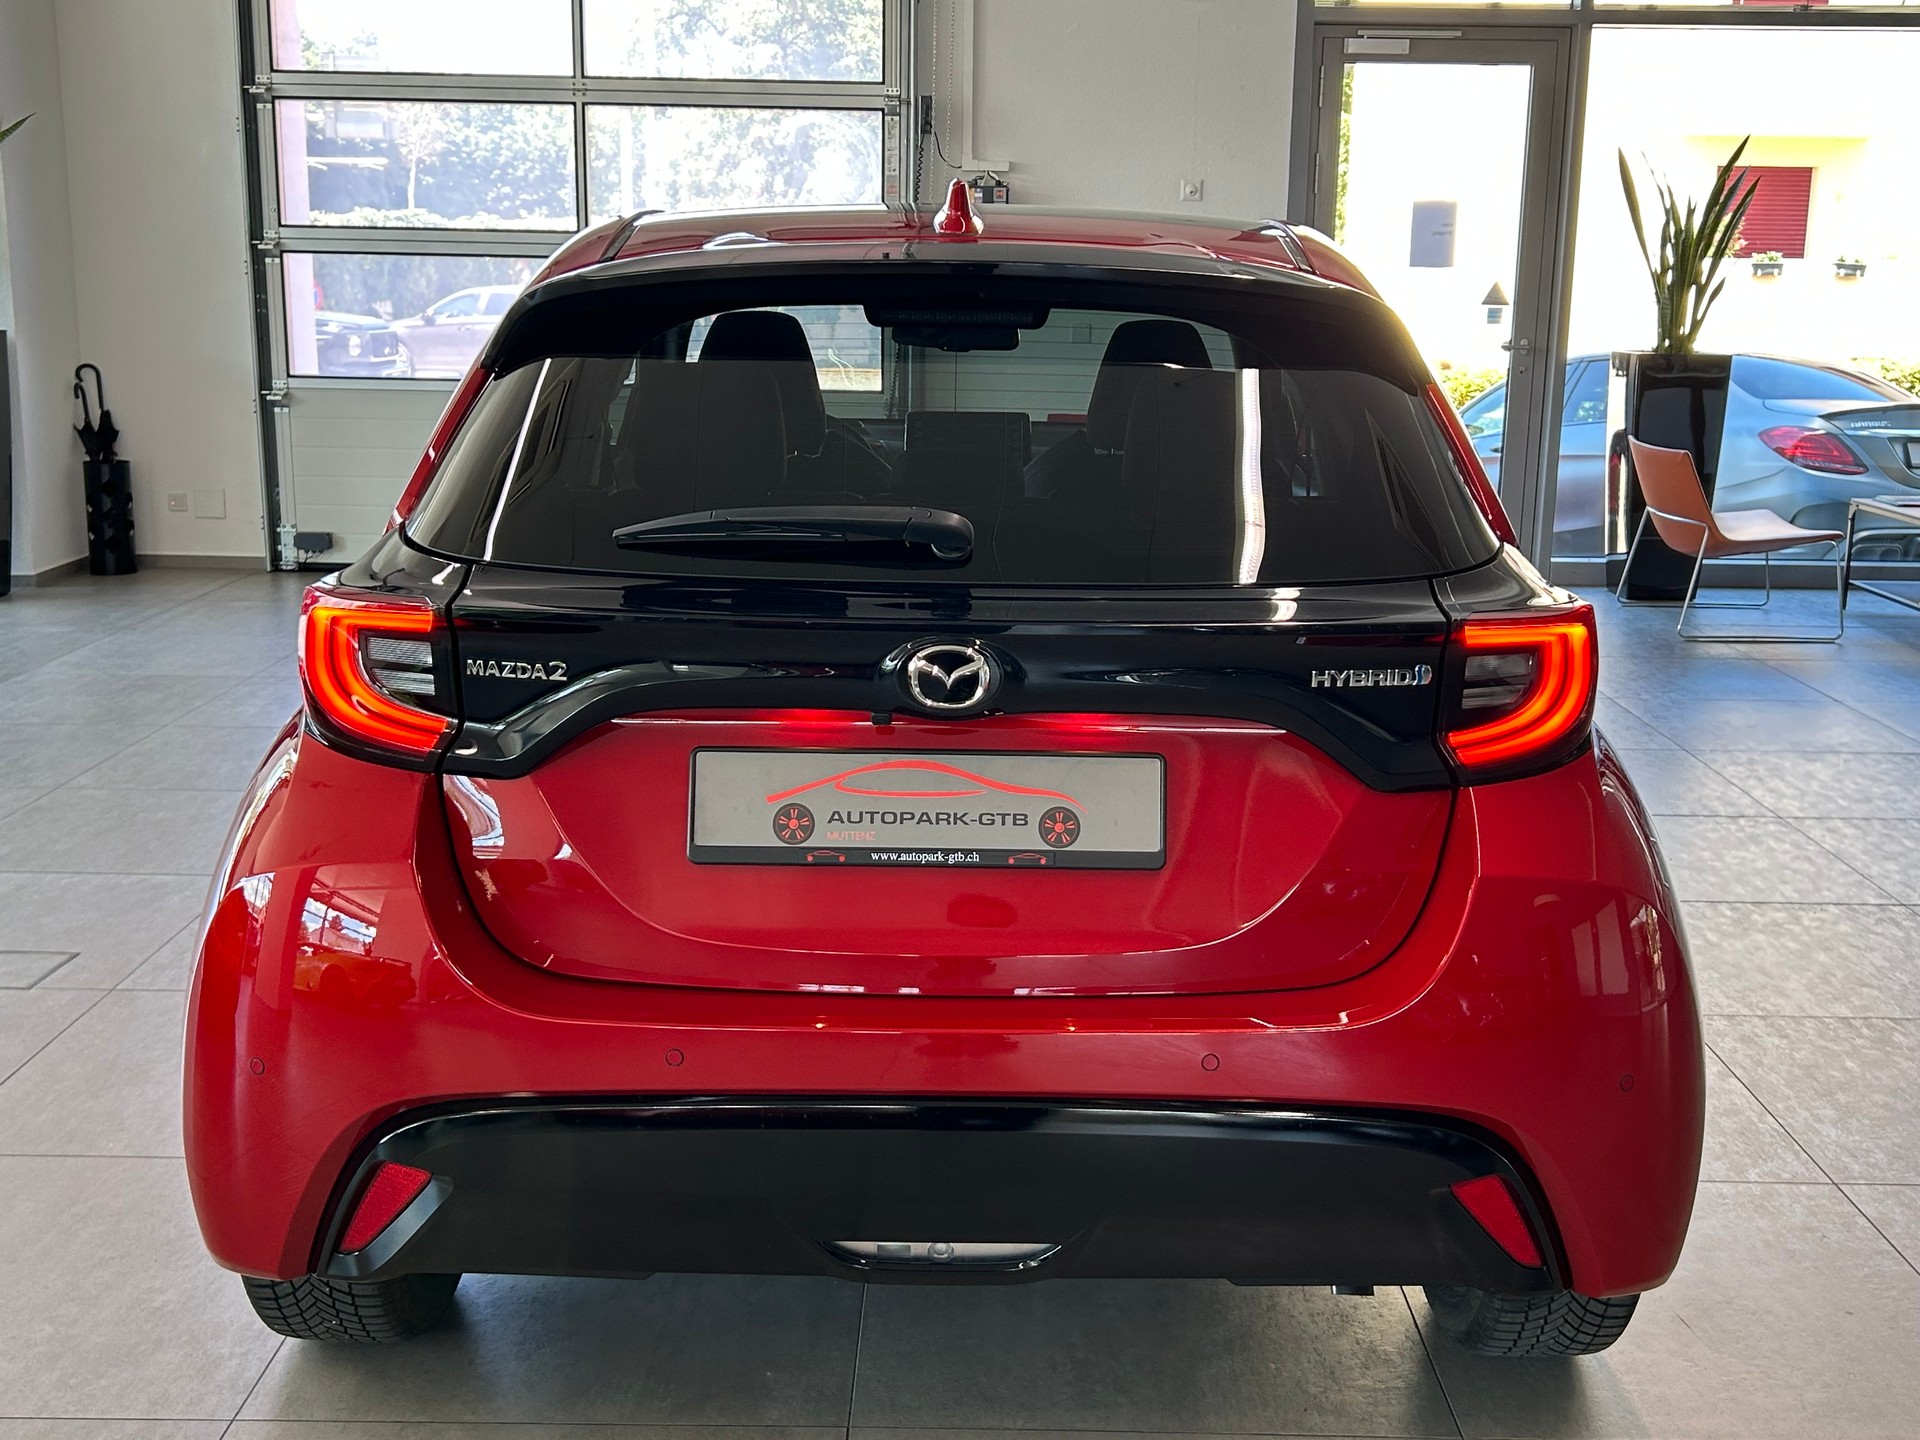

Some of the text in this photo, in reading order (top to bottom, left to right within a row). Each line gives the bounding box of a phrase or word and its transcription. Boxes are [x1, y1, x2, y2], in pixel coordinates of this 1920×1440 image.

[466, 659, 567, 681] MAZDA2
[1311, 669, 1414, 687] HYBRID
[827, 810, 1029, 827] AUTOPARK-GTB
[826, 831, 876, 841] MUTTENZ
[871, 851, 980, 864] www.autopark-gtb.ch
